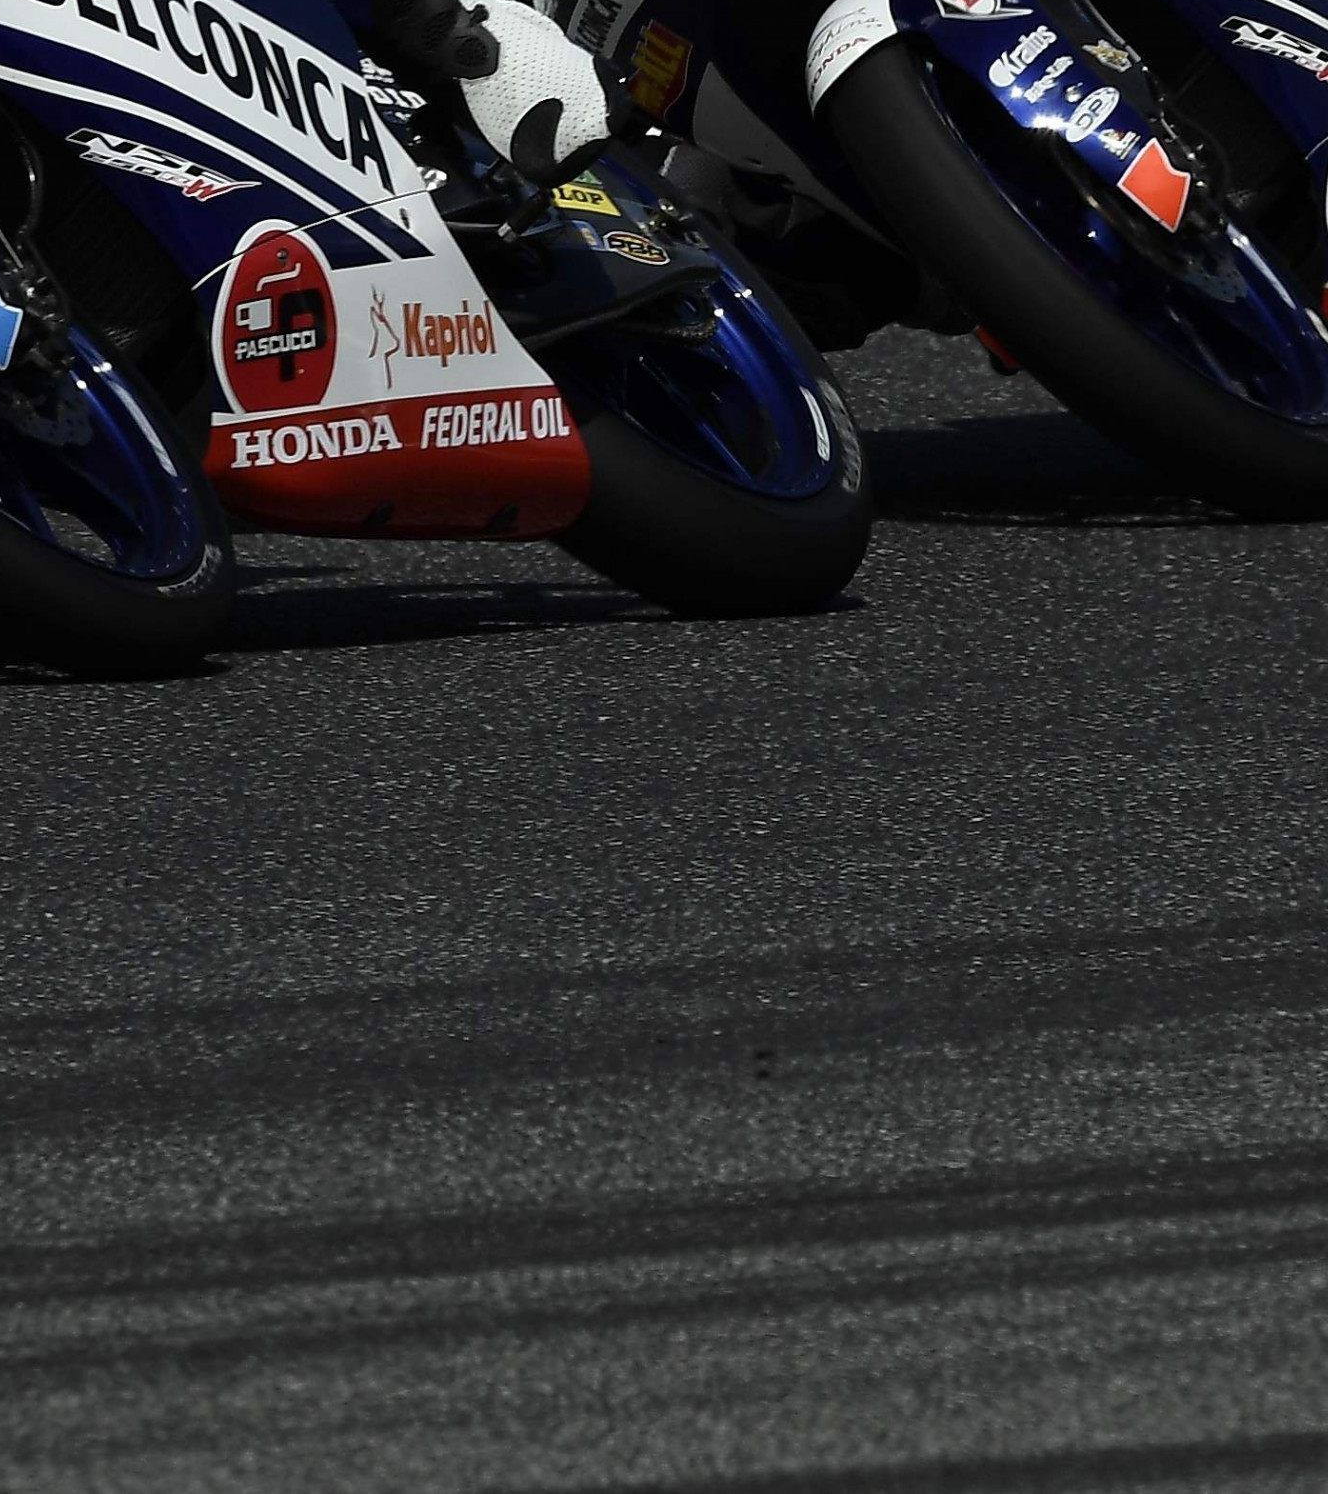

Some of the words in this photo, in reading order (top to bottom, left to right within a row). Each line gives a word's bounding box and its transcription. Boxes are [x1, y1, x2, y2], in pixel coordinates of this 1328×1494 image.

[810, 37, 870, 98] ONDA
[558, 187, 605, 206] LOP
[234, 329, 317, 361] PASCUCCI
[401, 299, 498, 368] Kapriol
[231, 414, 403, 470] HONDA
[420, 400, 528, 450] FEDERAL
[531, 397, 571, 438] OIL
